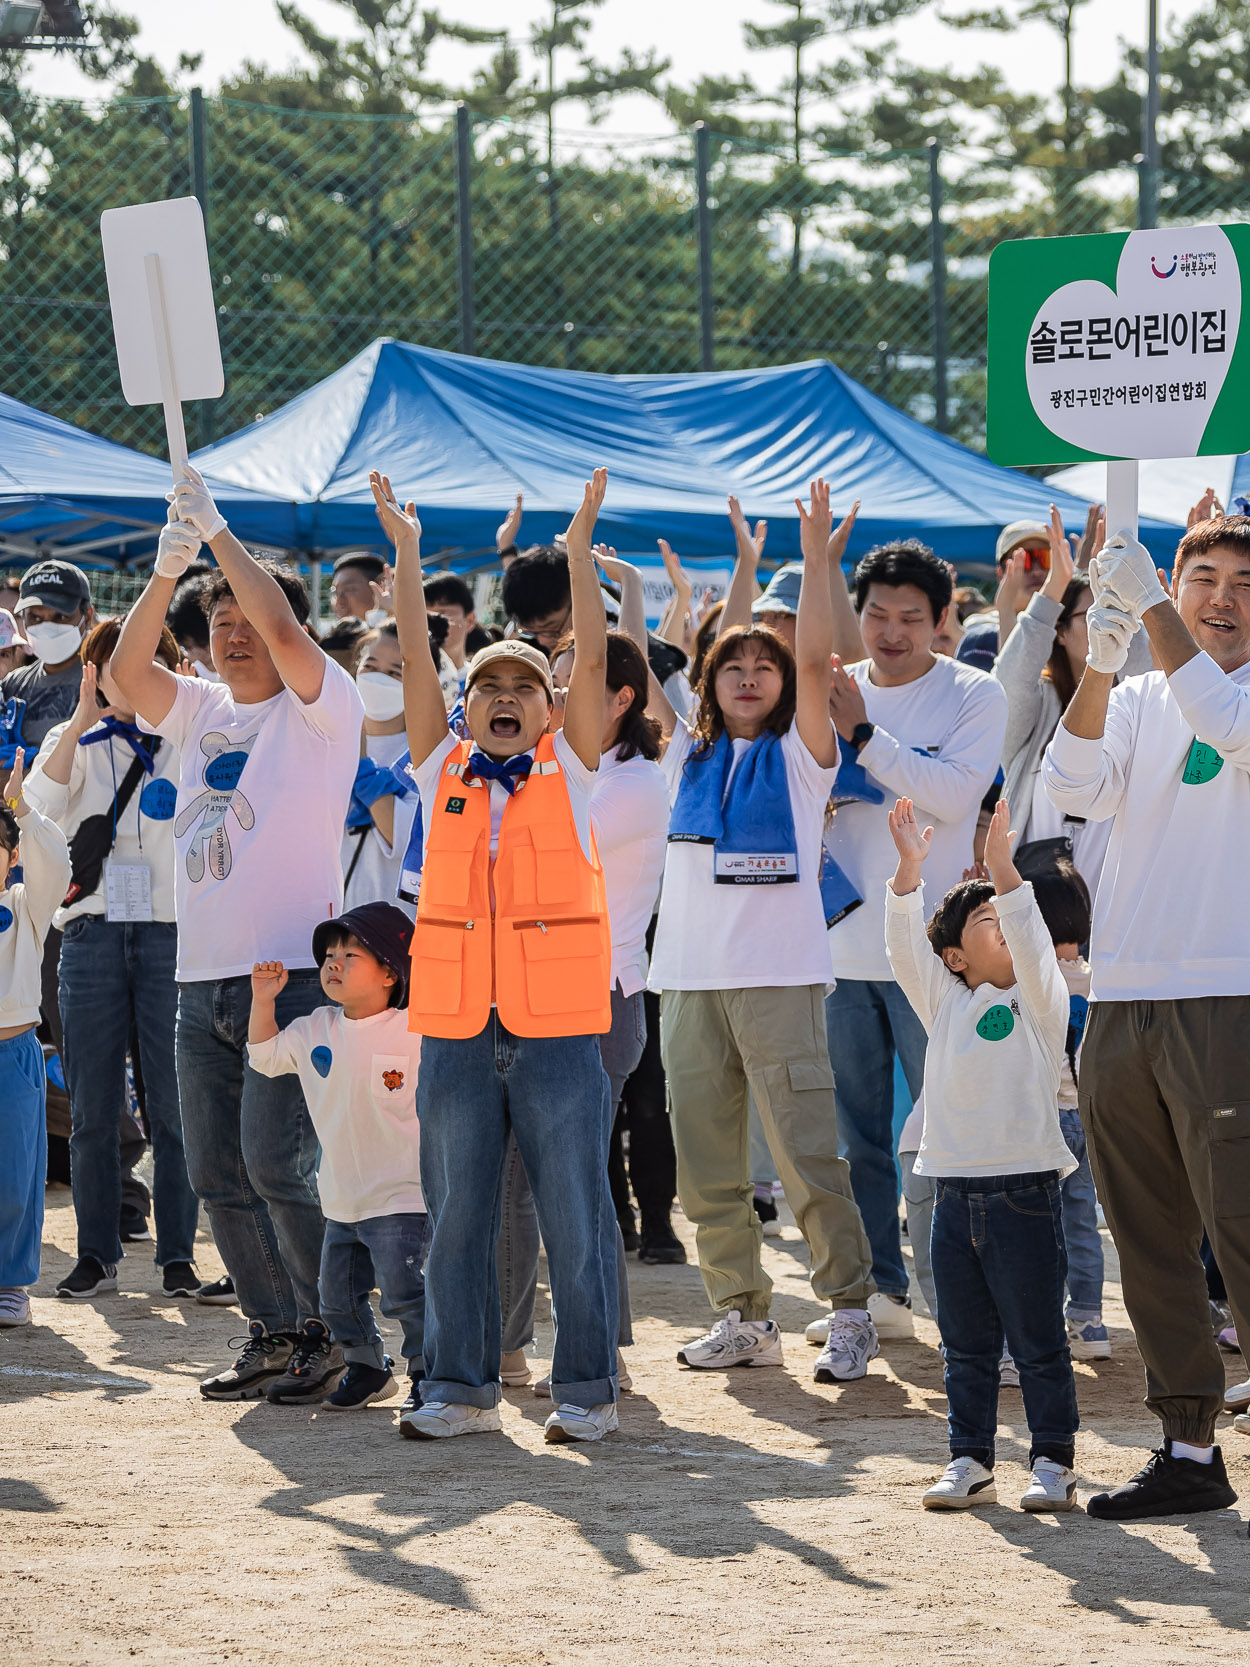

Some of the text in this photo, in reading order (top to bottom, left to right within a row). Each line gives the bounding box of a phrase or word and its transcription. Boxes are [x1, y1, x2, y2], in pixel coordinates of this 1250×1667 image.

[1180, 260, 1216, 278] 행복광진
[1030, 309, 1226, 364] 솔로몬어린이집
[1050, 380, 1207, 409] 광진구민간어린이집연합회
[29, 573, 64, 586] LOCAL
[735, 875, 777, 884] OMAR SHARIF
